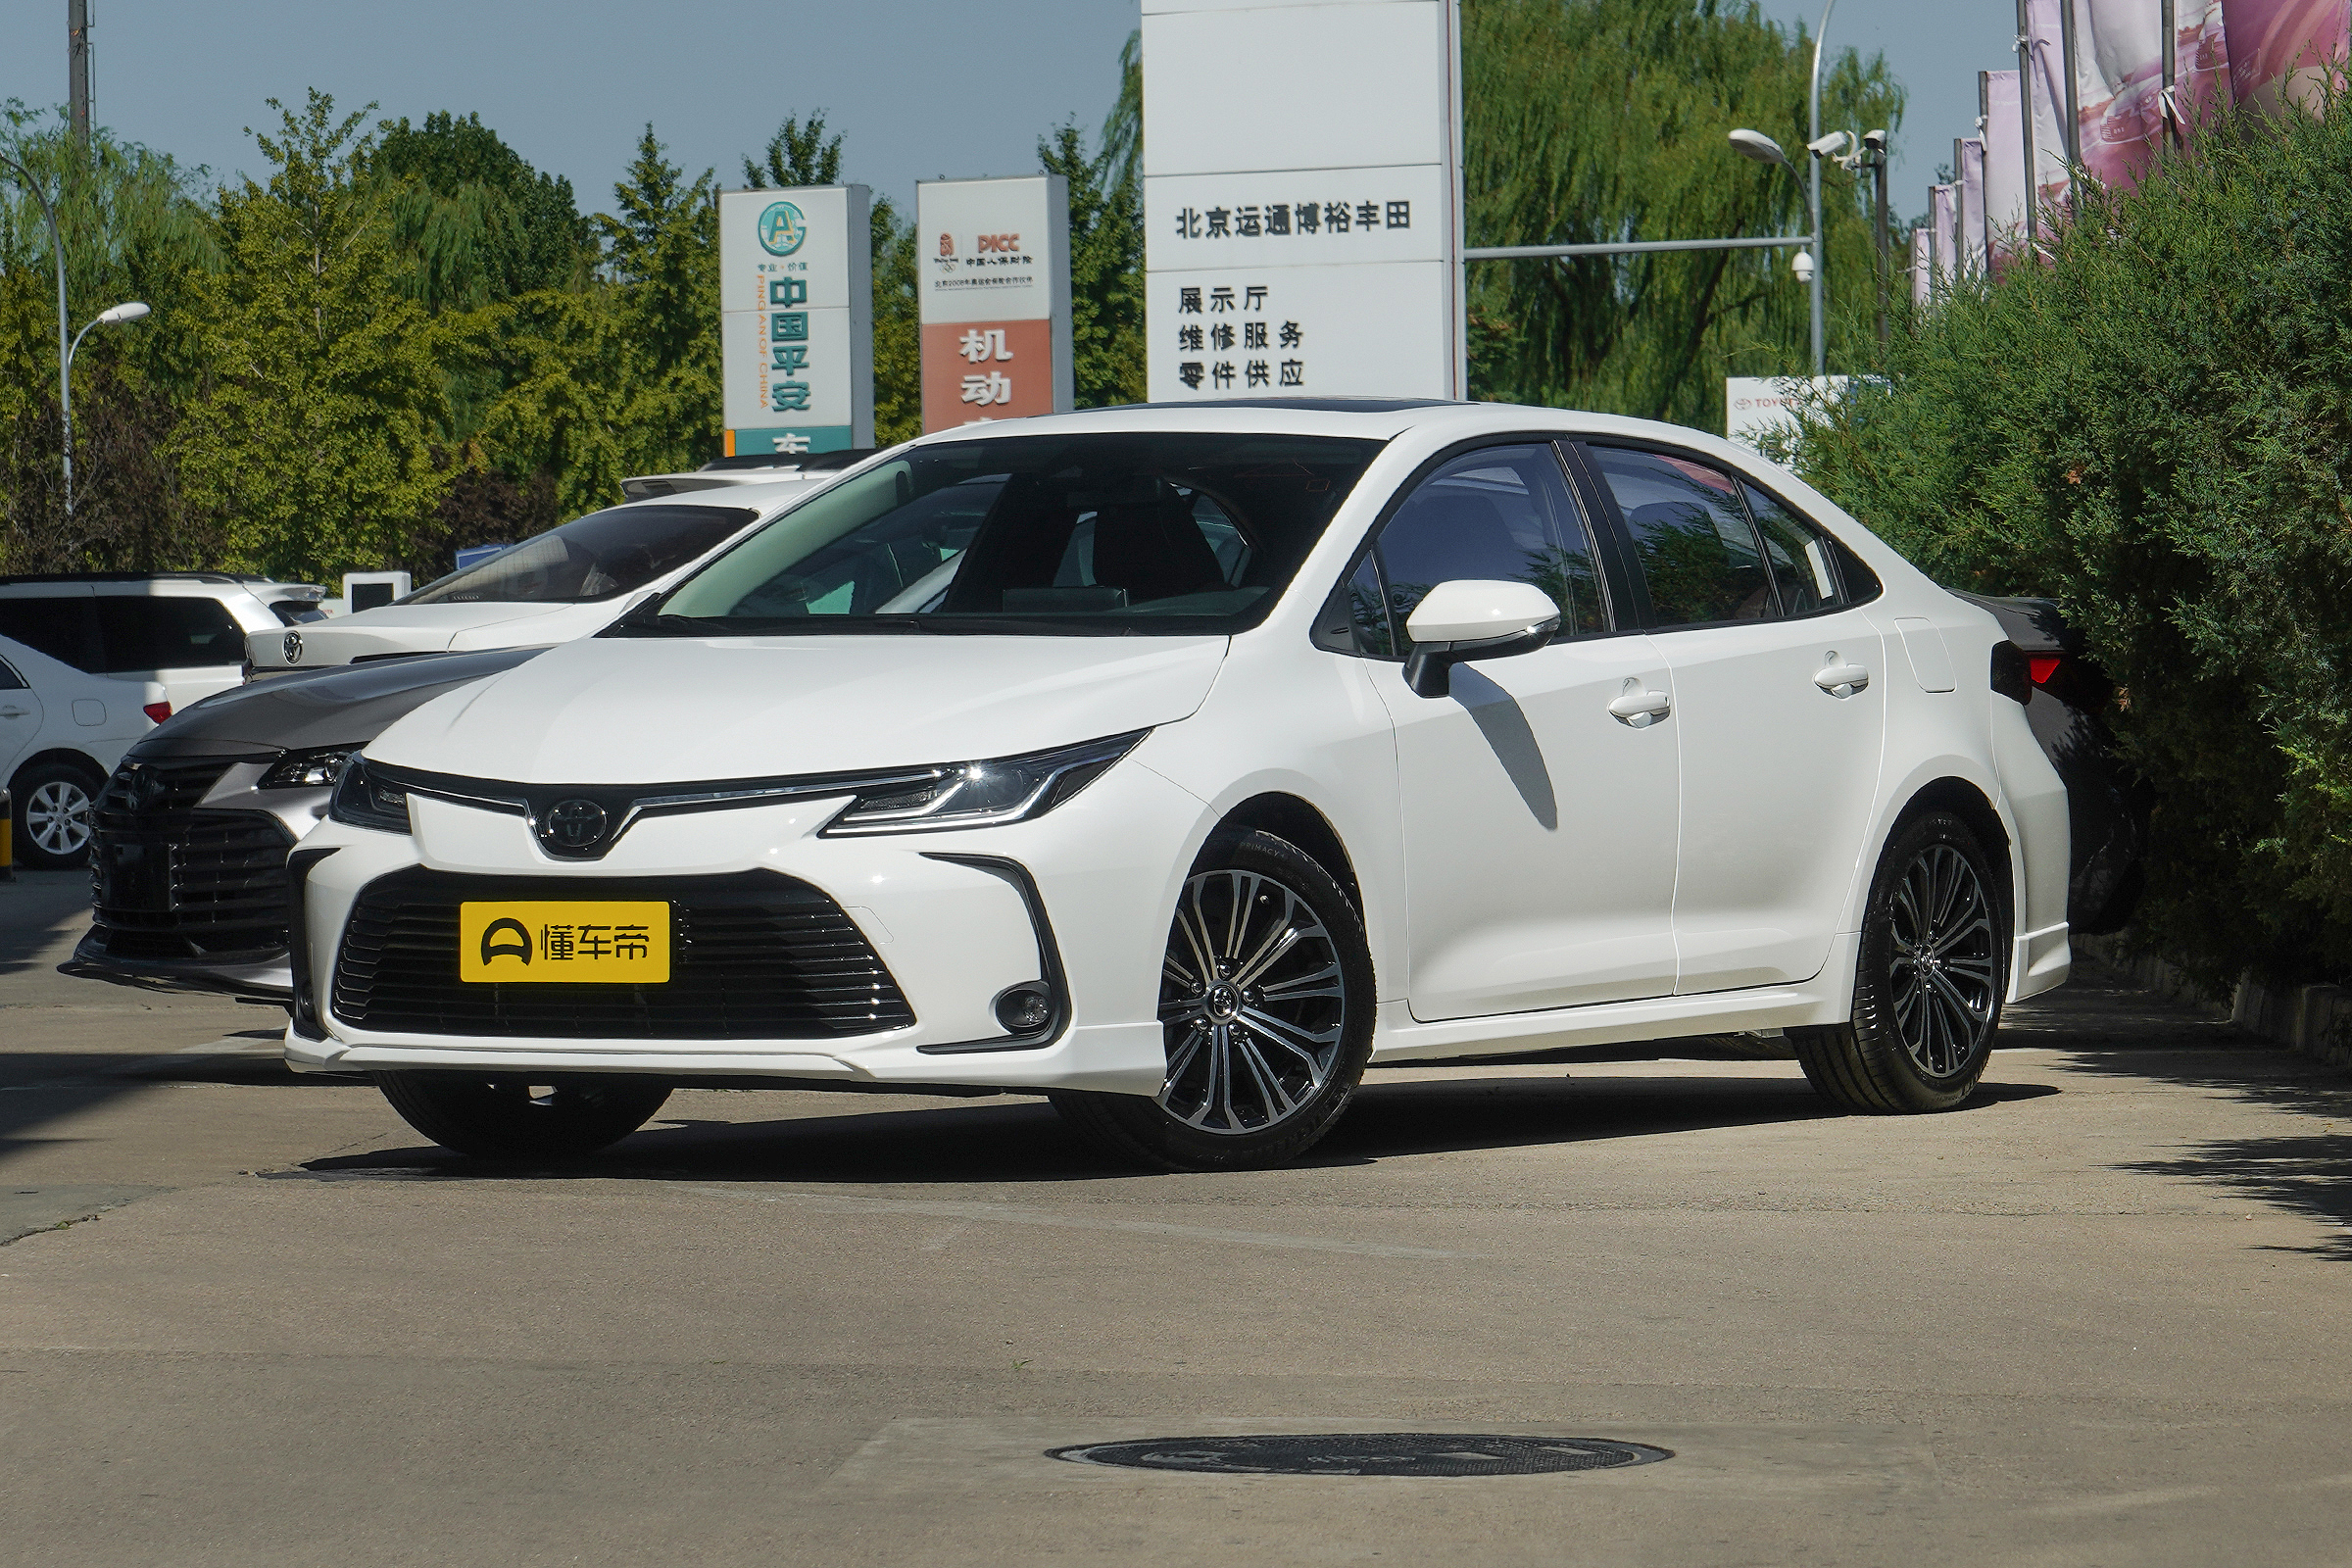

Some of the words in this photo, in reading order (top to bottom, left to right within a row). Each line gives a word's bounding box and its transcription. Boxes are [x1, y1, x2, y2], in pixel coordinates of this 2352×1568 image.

[1176, 200, 1411, 239] 北京运通博裕丰田
[978, 233, 1020, 253] PICC
[757, 273, 767, 312] PING
[1178, 285, 1268, 315] 展示厅
[769, 275, 811, 413] 中国平安
[1178, 319, 1304, 353] 维修服务
[759, 362, 769, 410] CHINA
[958, 328, 1014, 421] 机动
[1178, 358, 1305, 391] 零件供应
[1755, 398, 1801, 408] TOYT
[540, 923, 650, 960] 懂车帝
